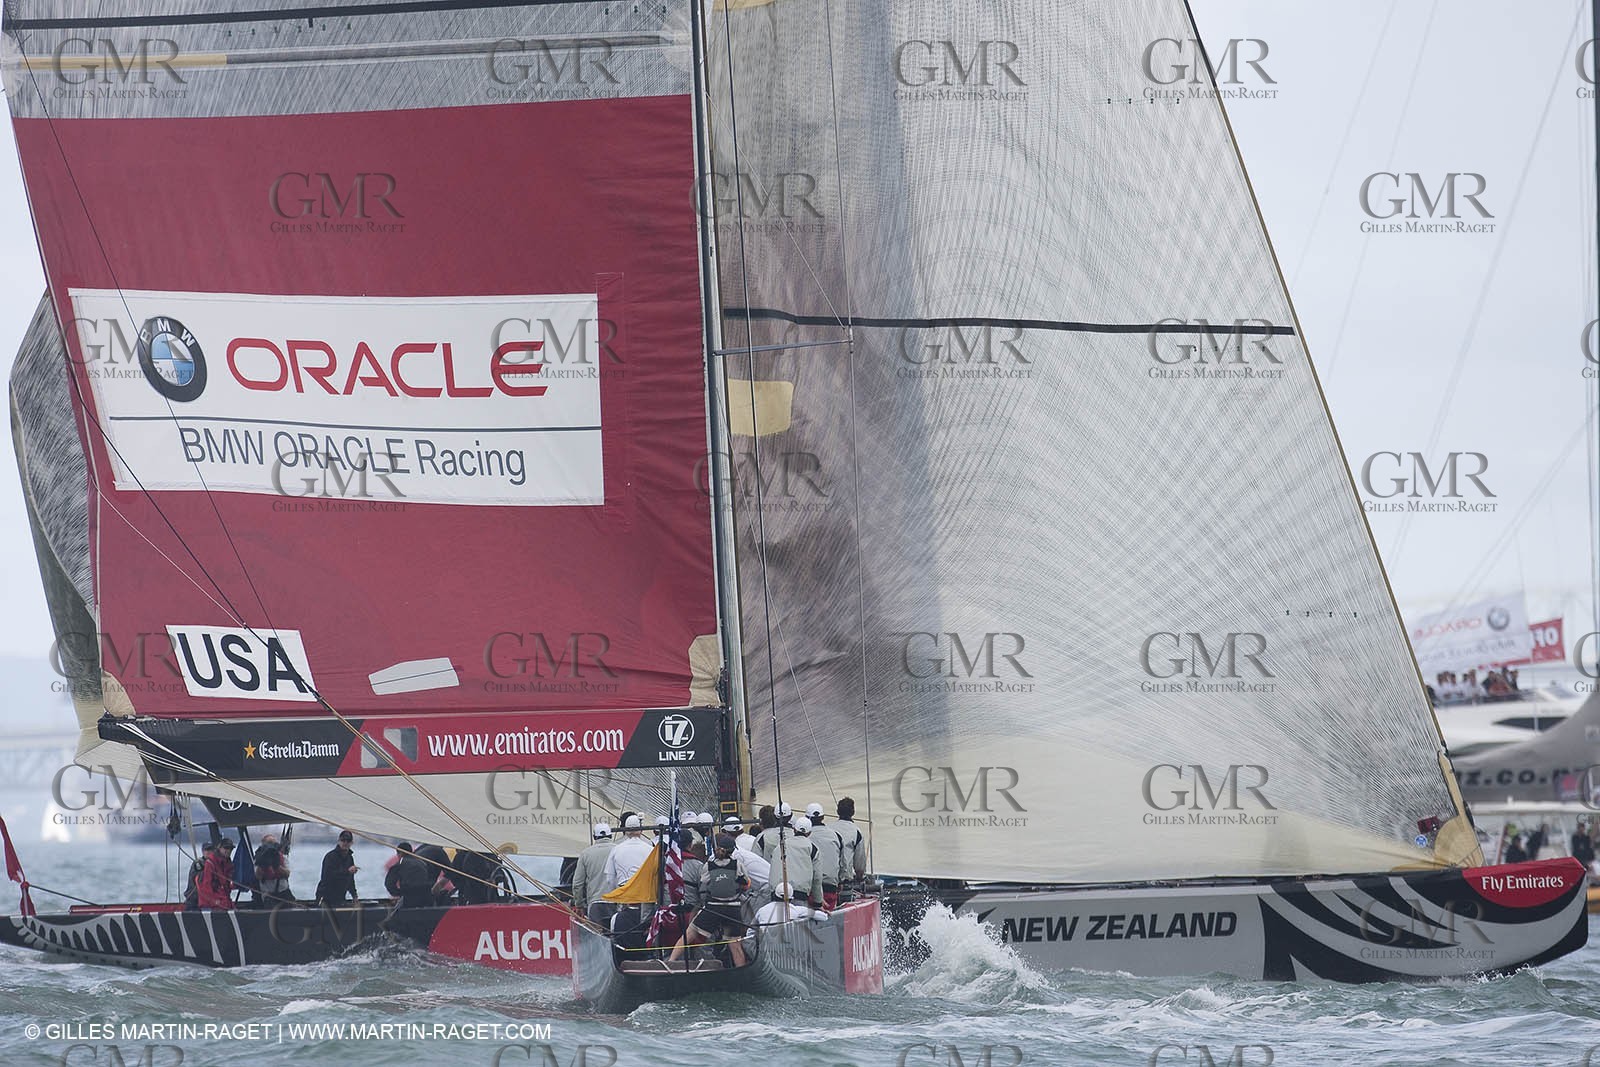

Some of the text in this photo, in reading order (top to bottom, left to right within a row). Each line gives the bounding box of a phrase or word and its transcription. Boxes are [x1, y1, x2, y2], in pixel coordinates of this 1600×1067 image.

[226, 337, 549, 398] ORACLE
[179, 427, 527, 486] BMW ORACLE Racing
[176, 632, 309, 694] USA
[427, 726, 625, 757] www.emirates.com
[1481, 874, 1564, 893] Fly Emirates
[1001, 911, 1238, 943] NEW ZEALAND
